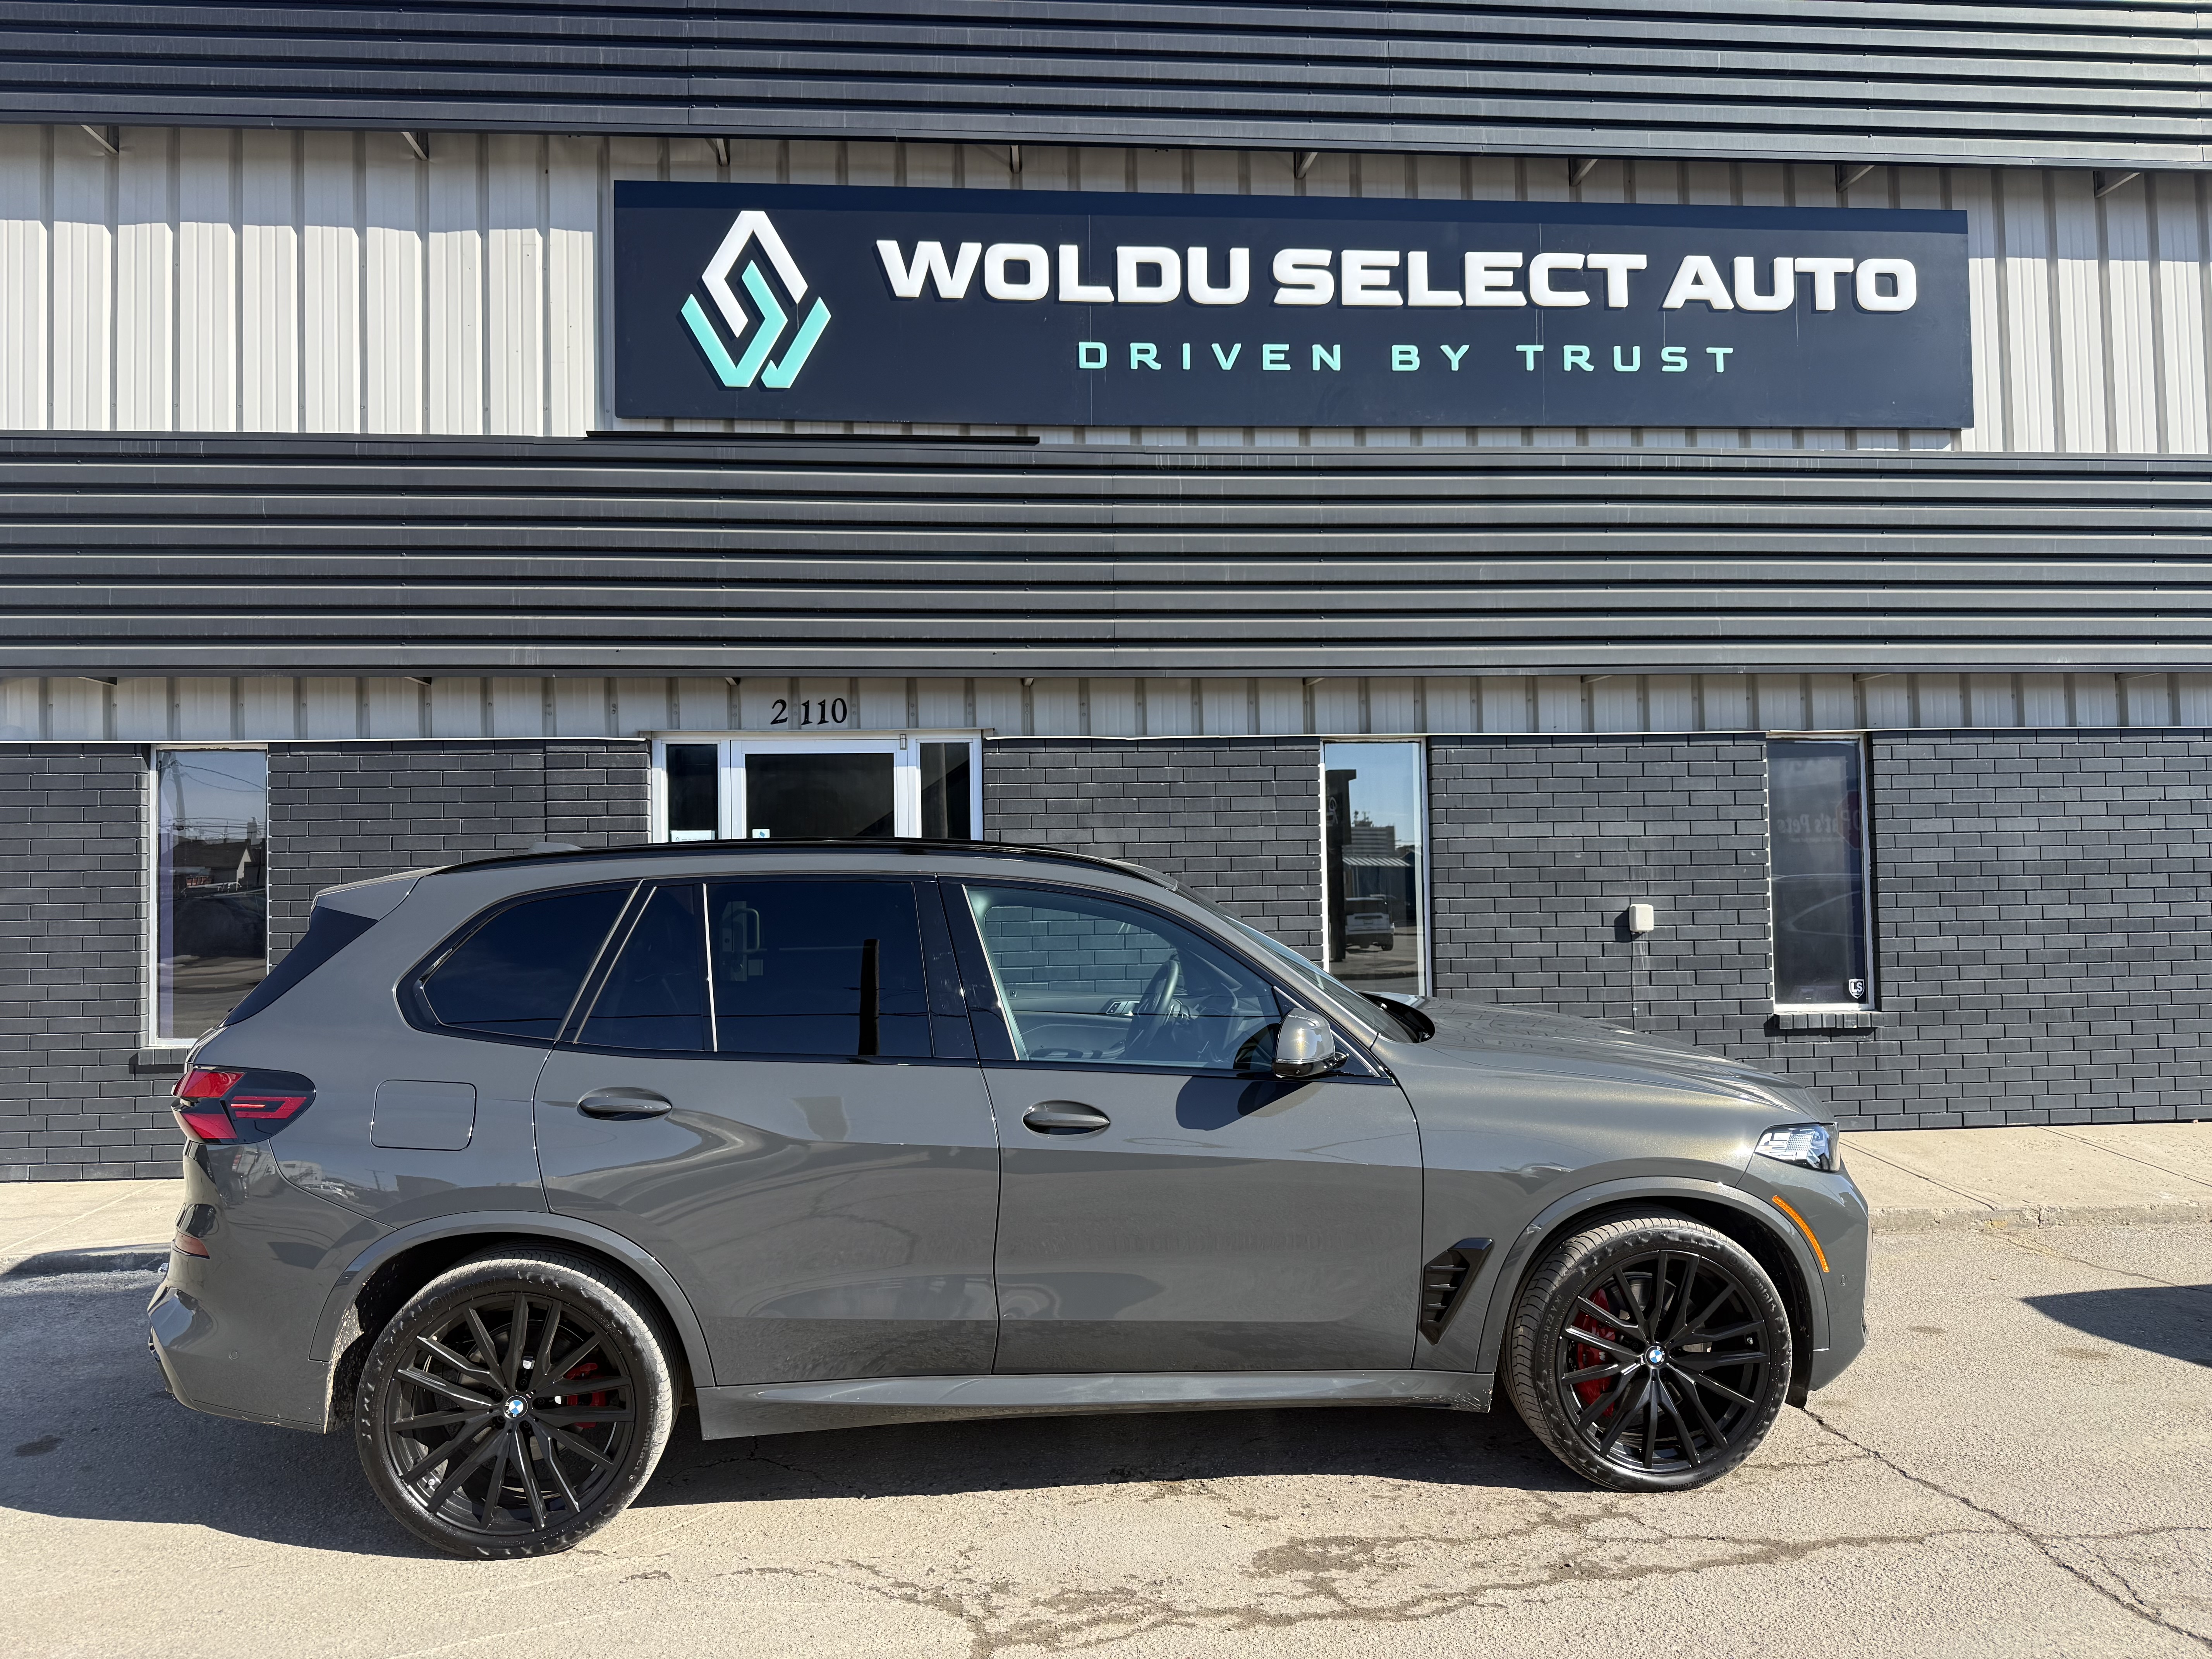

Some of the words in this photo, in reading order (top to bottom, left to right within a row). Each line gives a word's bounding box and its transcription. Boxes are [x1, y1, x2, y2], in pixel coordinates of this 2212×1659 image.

[876, 240, 1250, 305] WOLDU
[1273, 249, 1647, 308] SELECT
[1662, 255, 1917, 311] AUTO
[1079, 341, 1341, 371] DRIVEN
[1391, 344, 1470, 371] BY
[1517, 344, 1734, 373] TRUST
[1851, 982, 1863, 993] LS
